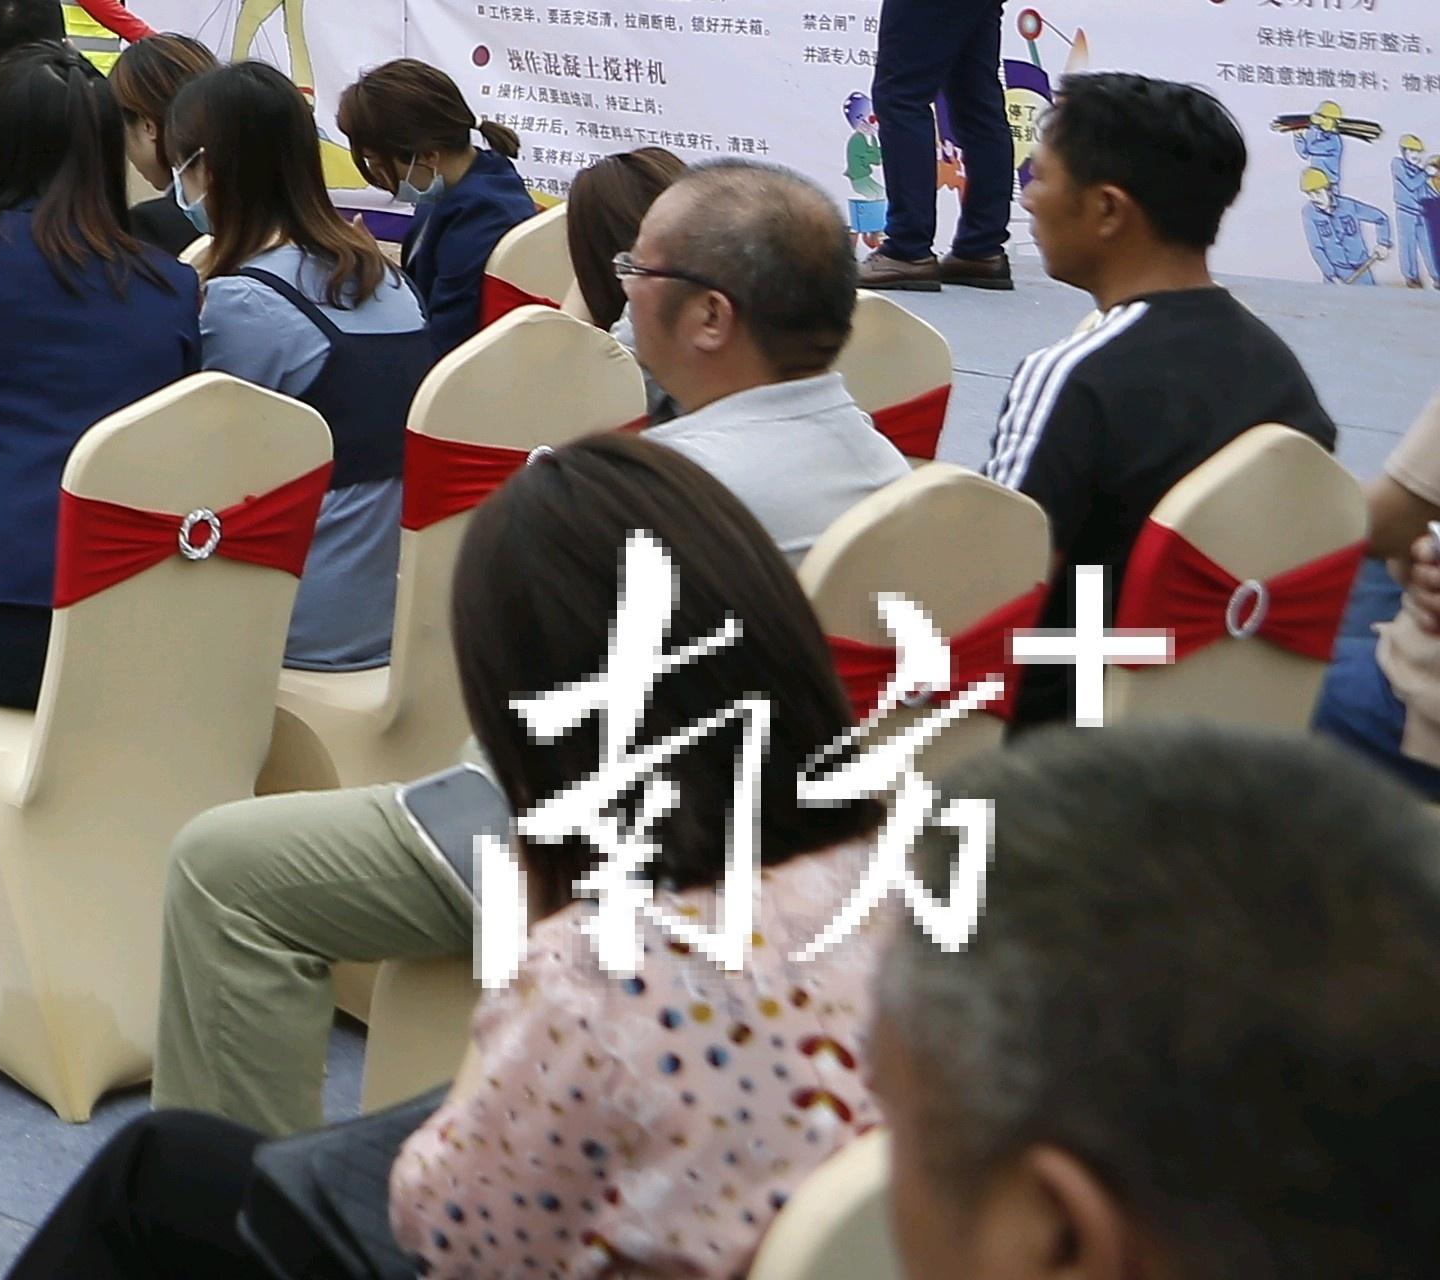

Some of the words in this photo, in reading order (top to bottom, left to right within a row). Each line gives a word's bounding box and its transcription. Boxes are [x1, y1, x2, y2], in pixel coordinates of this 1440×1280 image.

[507, 47, 668, 86] 操作混凝土搅拌机
